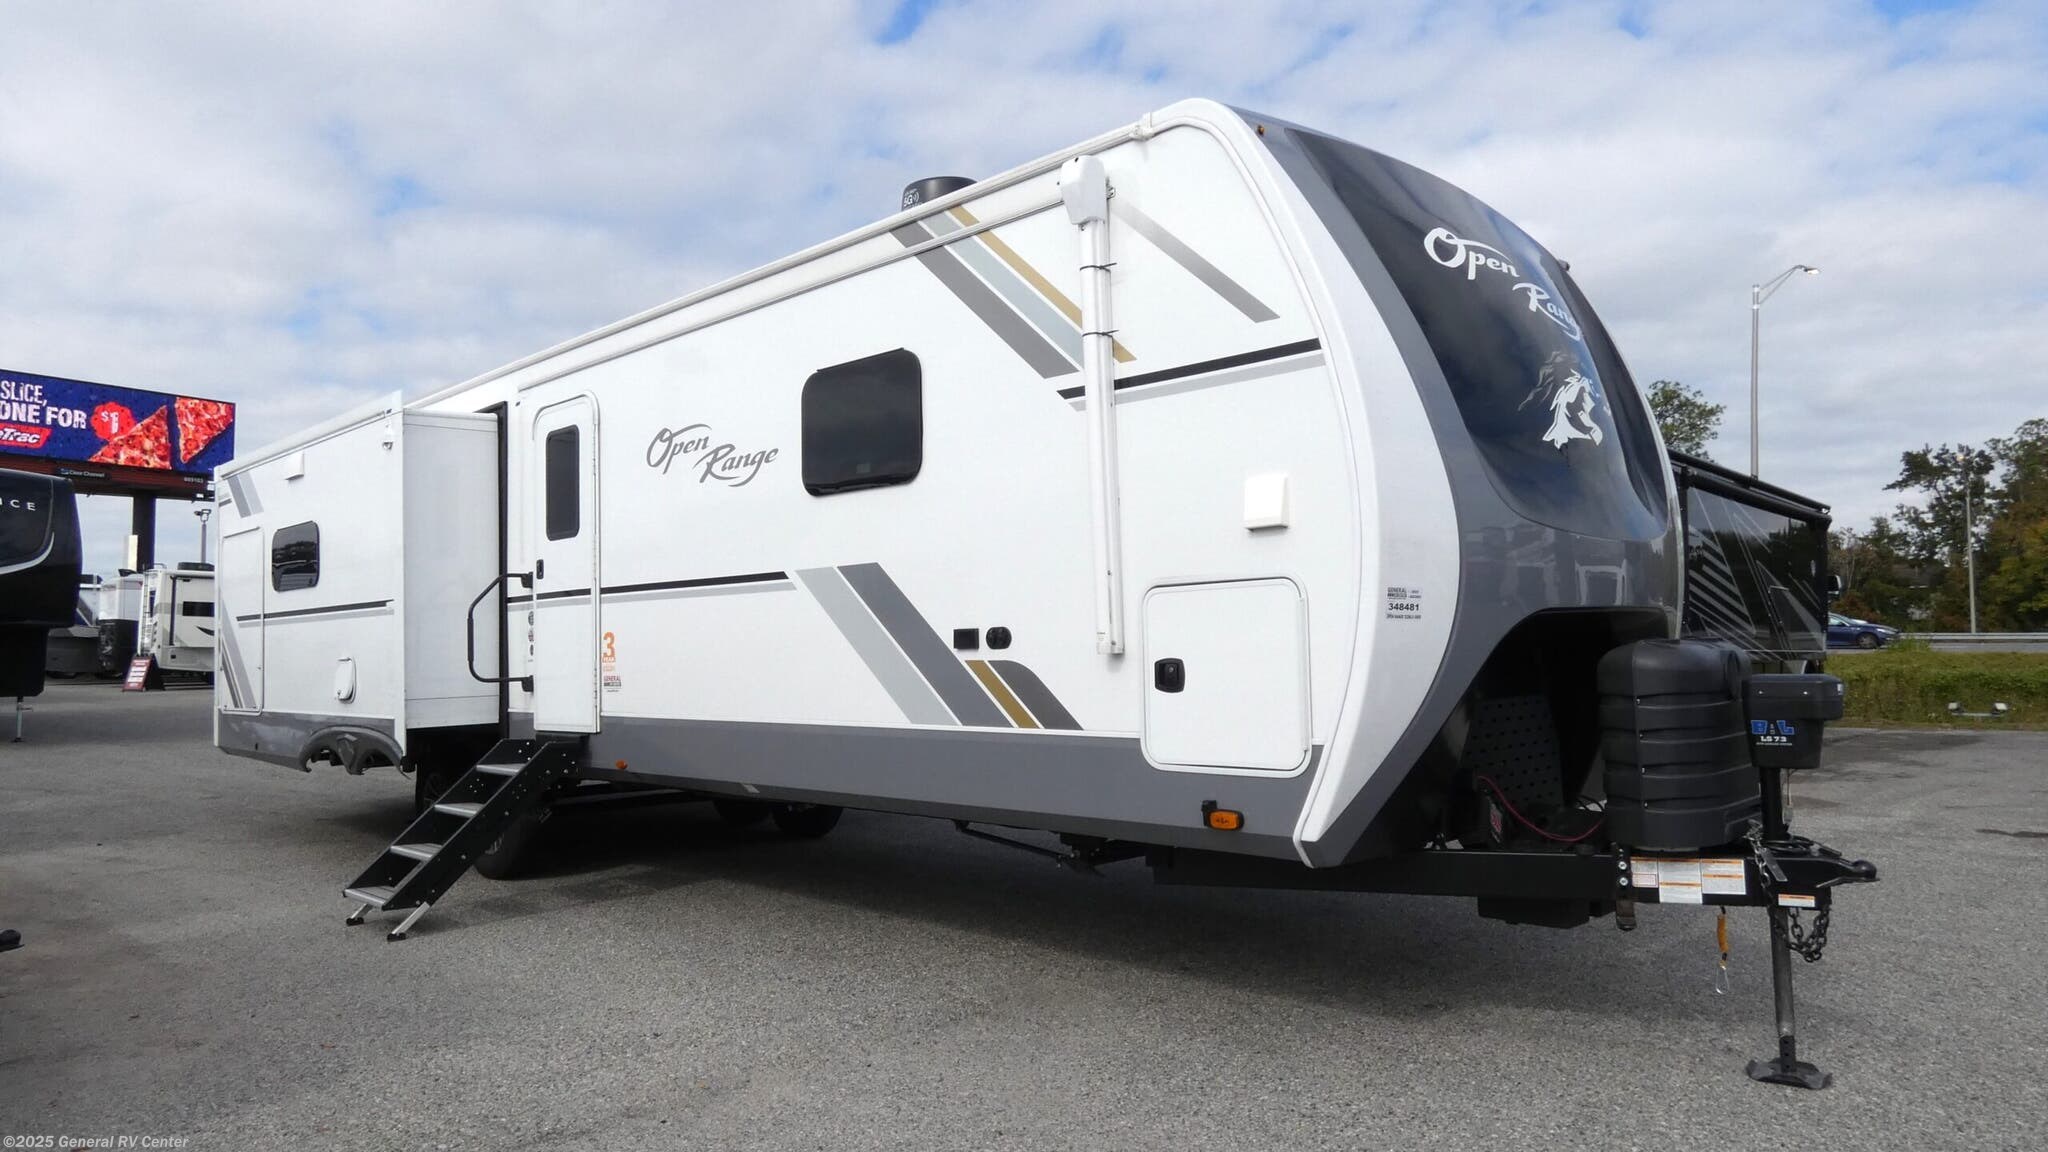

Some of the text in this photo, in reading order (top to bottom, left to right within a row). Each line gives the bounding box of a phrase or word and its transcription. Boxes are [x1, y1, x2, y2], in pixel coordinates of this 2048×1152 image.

[1423, 227, 1520, 280] Open
[46, 406, 88, 429] FOR
[101, 410, 119, 434] $1
[646, 423, 779, 488] Open Range
[0, 497, 36, 511] CE
[1388, 603, 1419, 611] 348481
[603, 631, 615, 657] 3
